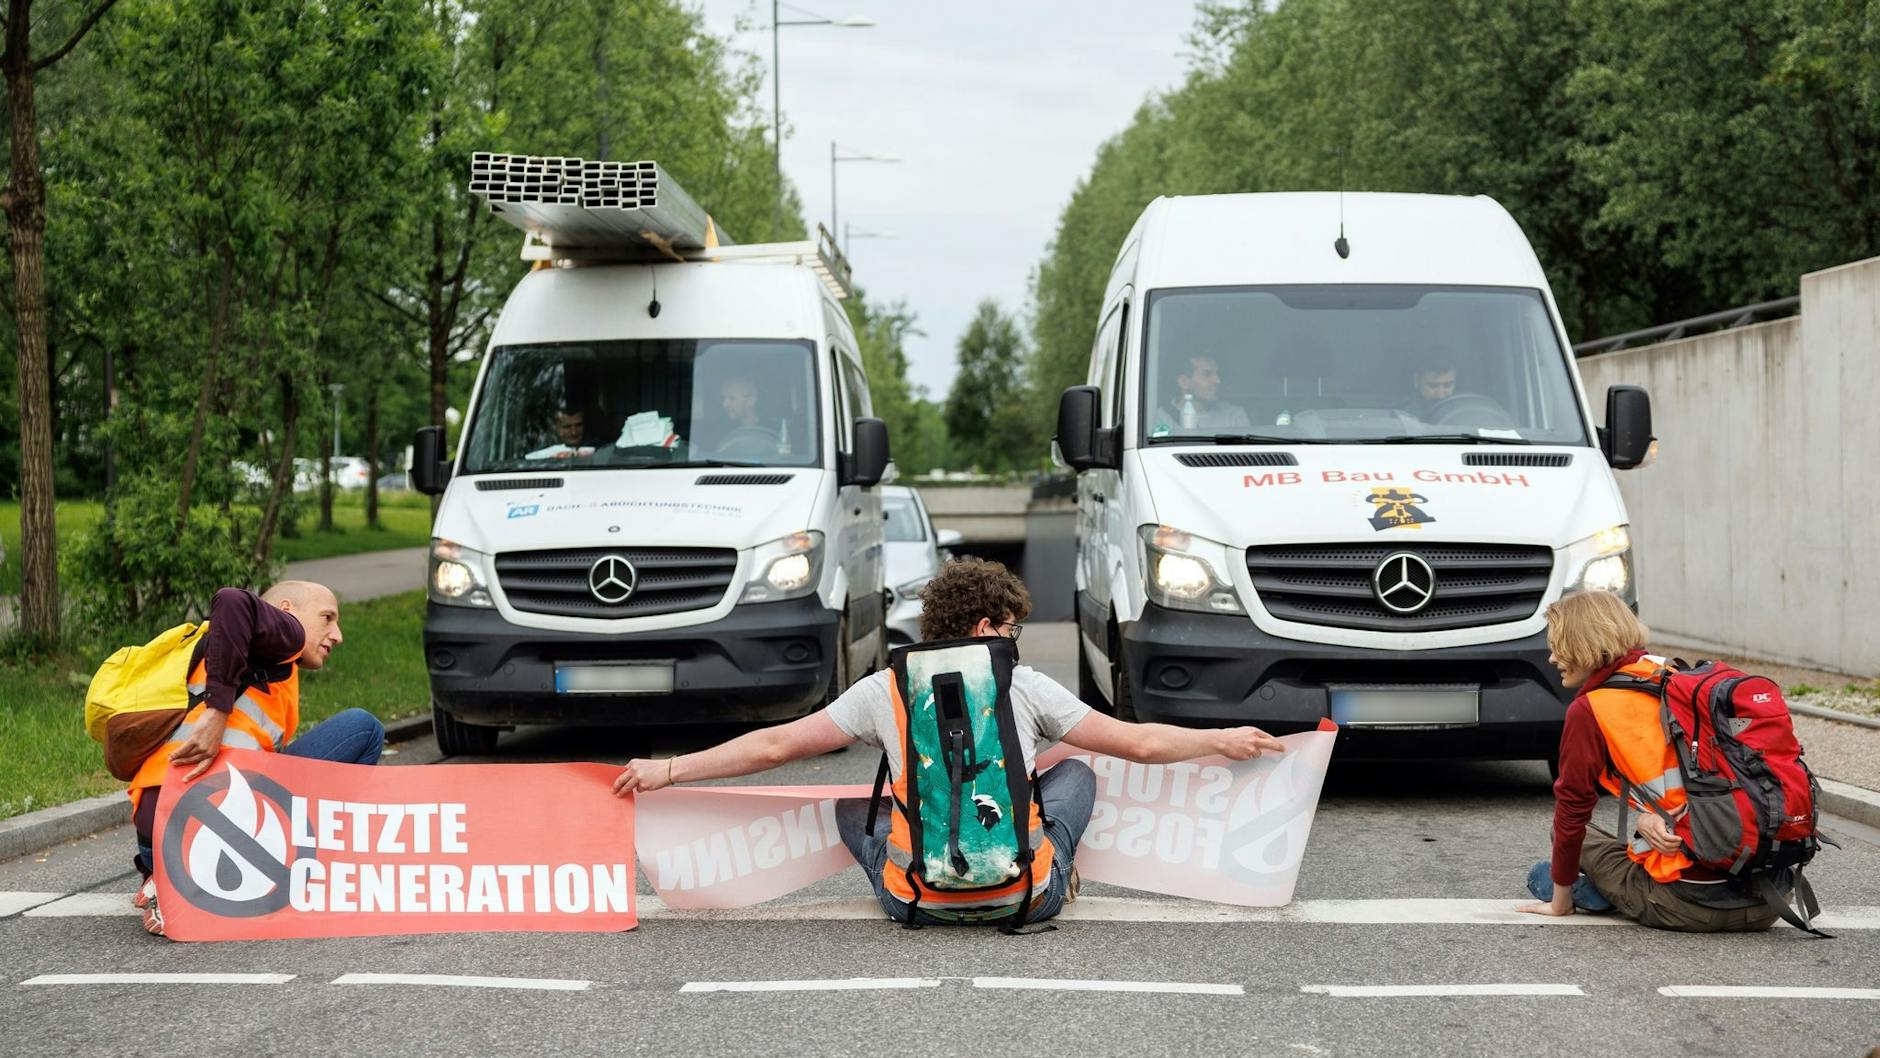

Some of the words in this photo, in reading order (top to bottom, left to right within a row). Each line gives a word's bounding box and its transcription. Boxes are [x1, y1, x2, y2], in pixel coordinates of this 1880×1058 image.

[1242, 471, 1302, 488] MB
[1321, 470, 1395, 482] Bau
[1412, 469, 1530, 488] GmbH
[291, 794, 469, 854] LETZTE
[288, 857, 629, 914] GENERATION
